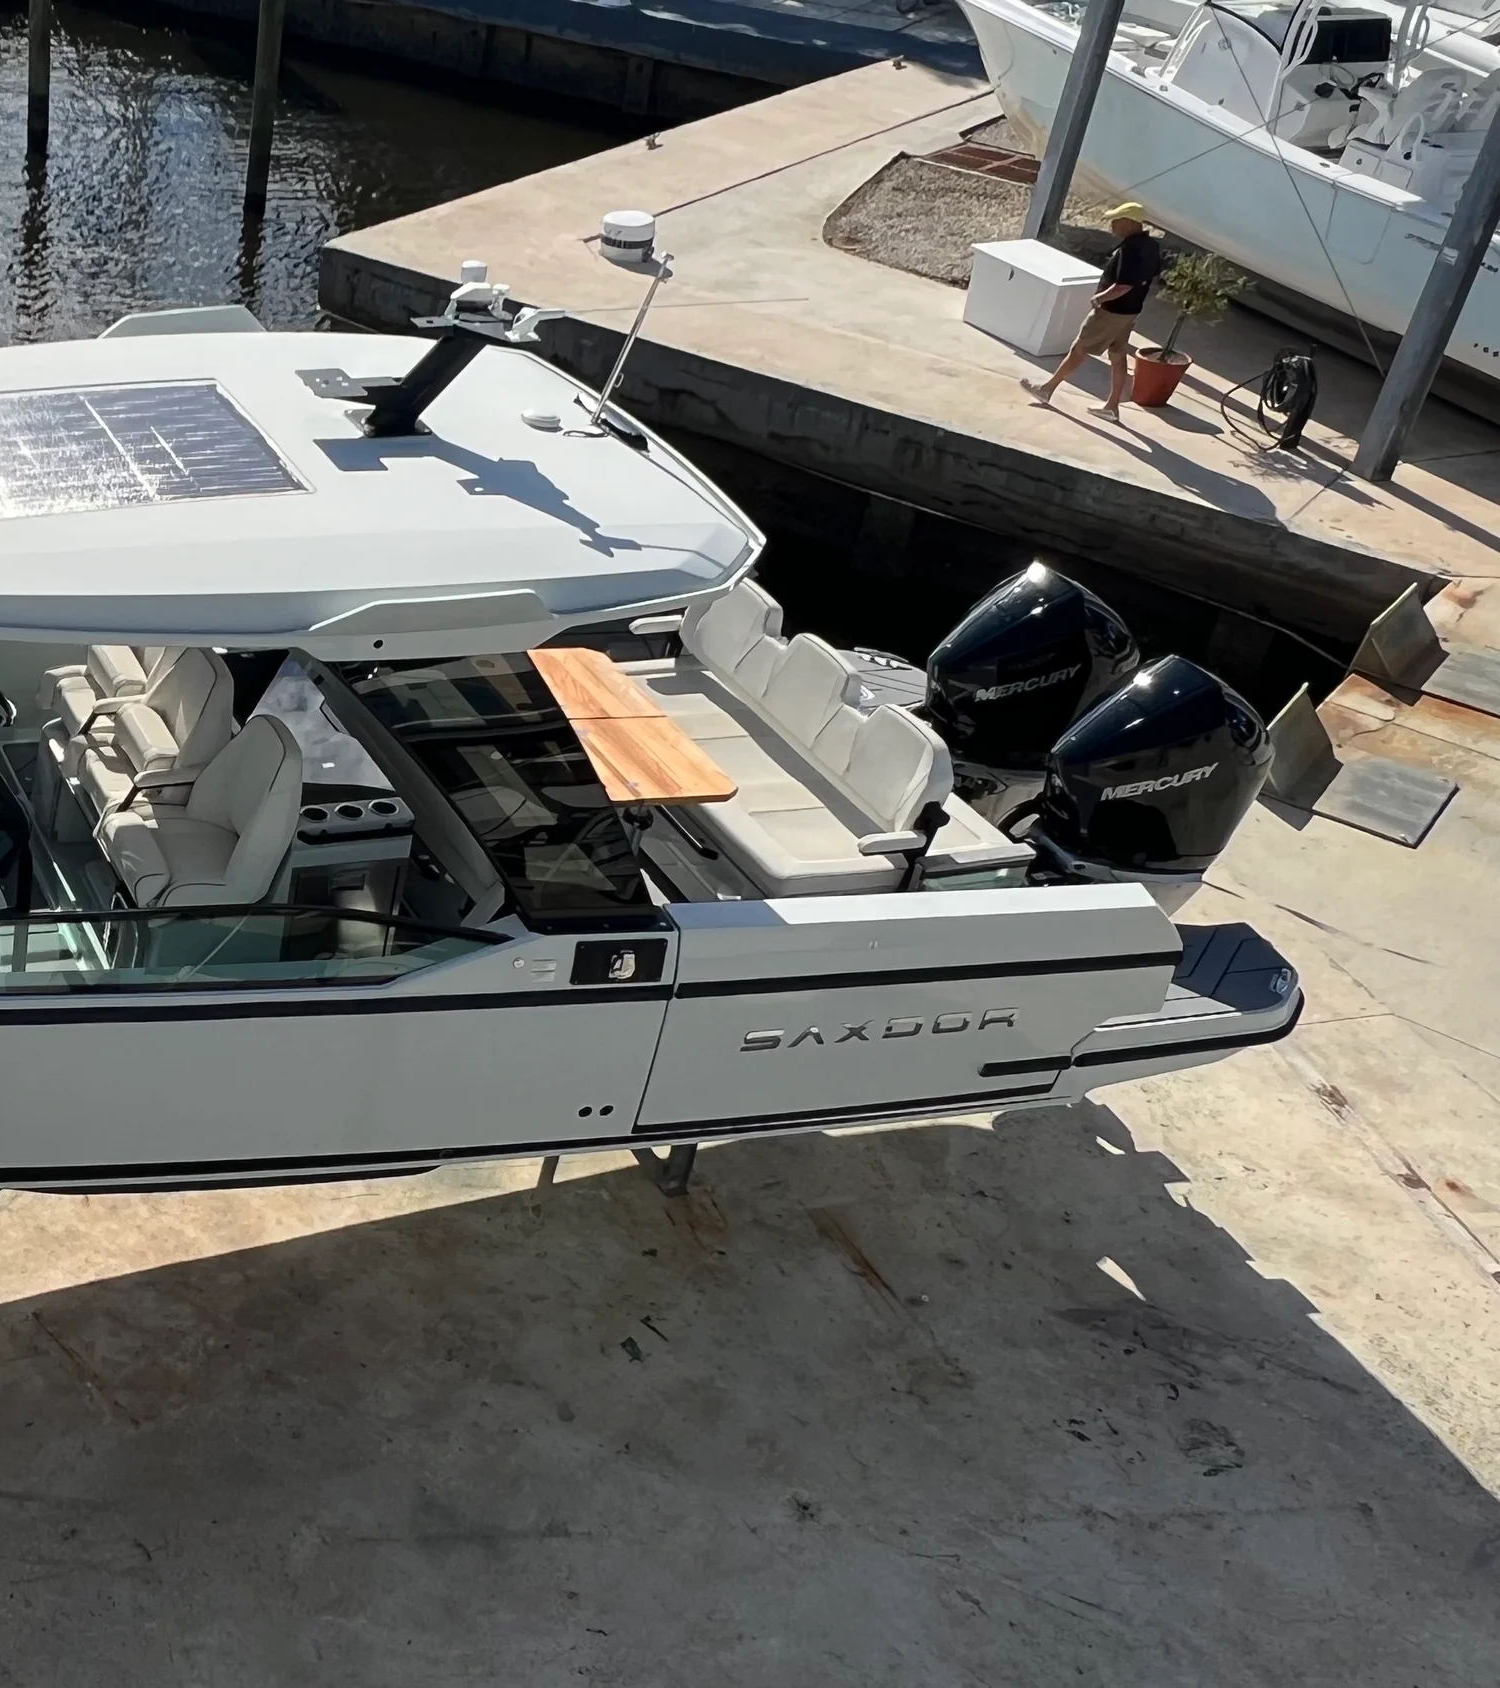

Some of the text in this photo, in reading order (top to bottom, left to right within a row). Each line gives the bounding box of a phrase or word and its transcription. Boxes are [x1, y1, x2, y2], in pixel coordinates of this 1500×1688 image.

[974, 663, 1082, 702] MERCURY
[1100, 762, 1219, 801] MERCURY
[739, 1007, 1020, 1052] SAXDOR
